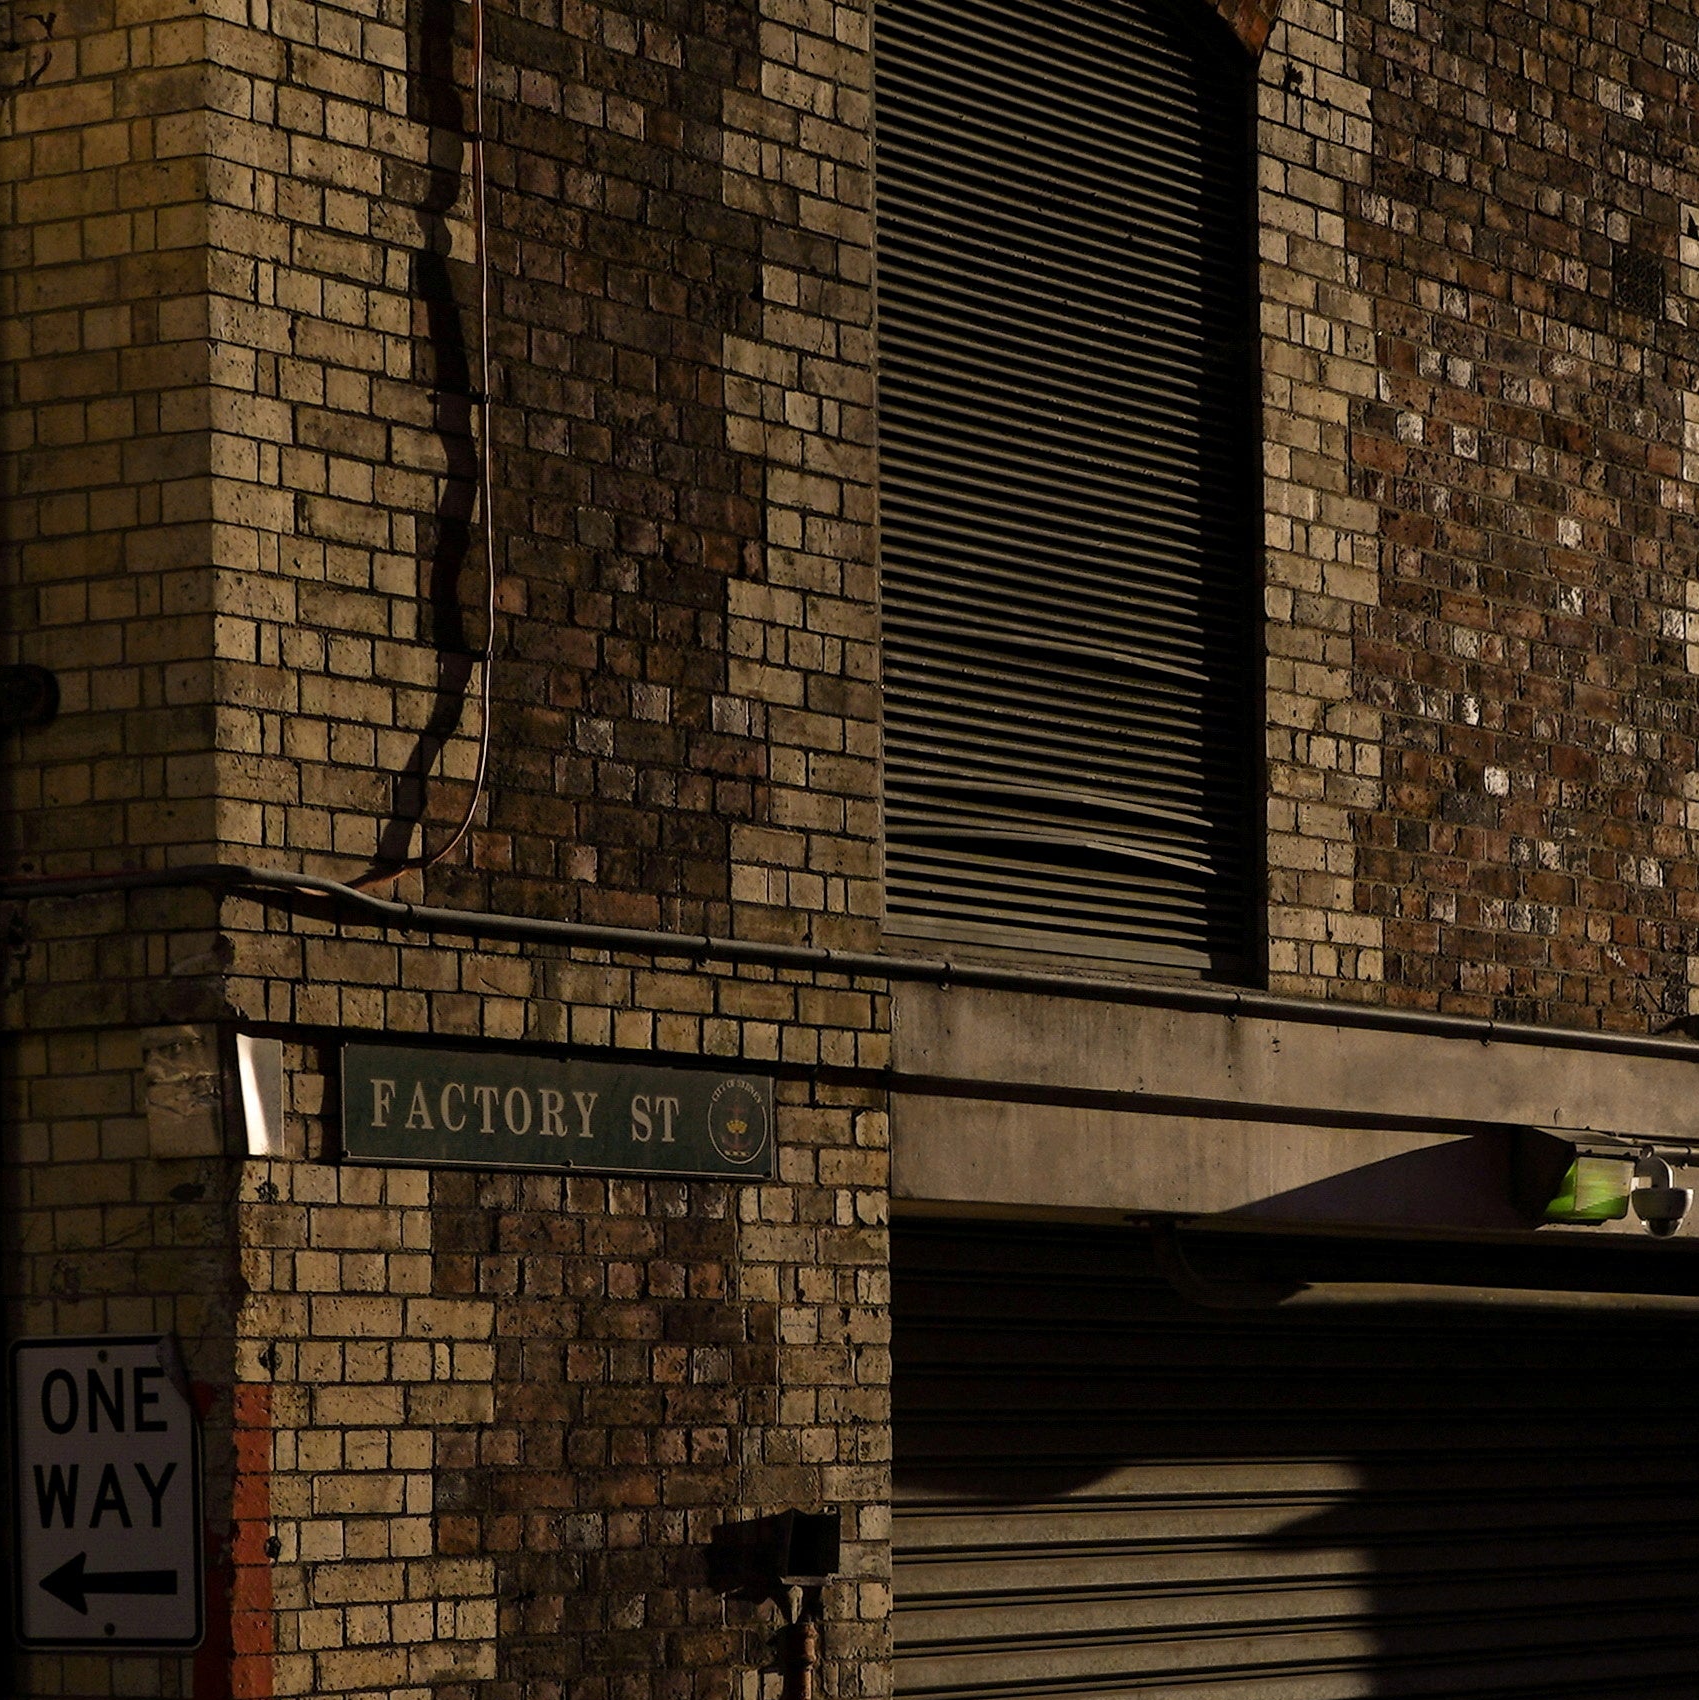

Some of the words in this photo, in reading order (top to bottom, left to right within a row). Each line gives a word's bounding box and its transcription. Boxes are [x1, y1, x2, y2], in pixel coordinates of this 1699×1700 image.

[369, 1079, 598, 1139] FACTORY
[631, 1094, 681, 1143] ST
[41, 1367, 168, 1434] ONE
[33, 1462, 177, 1529] WAY
